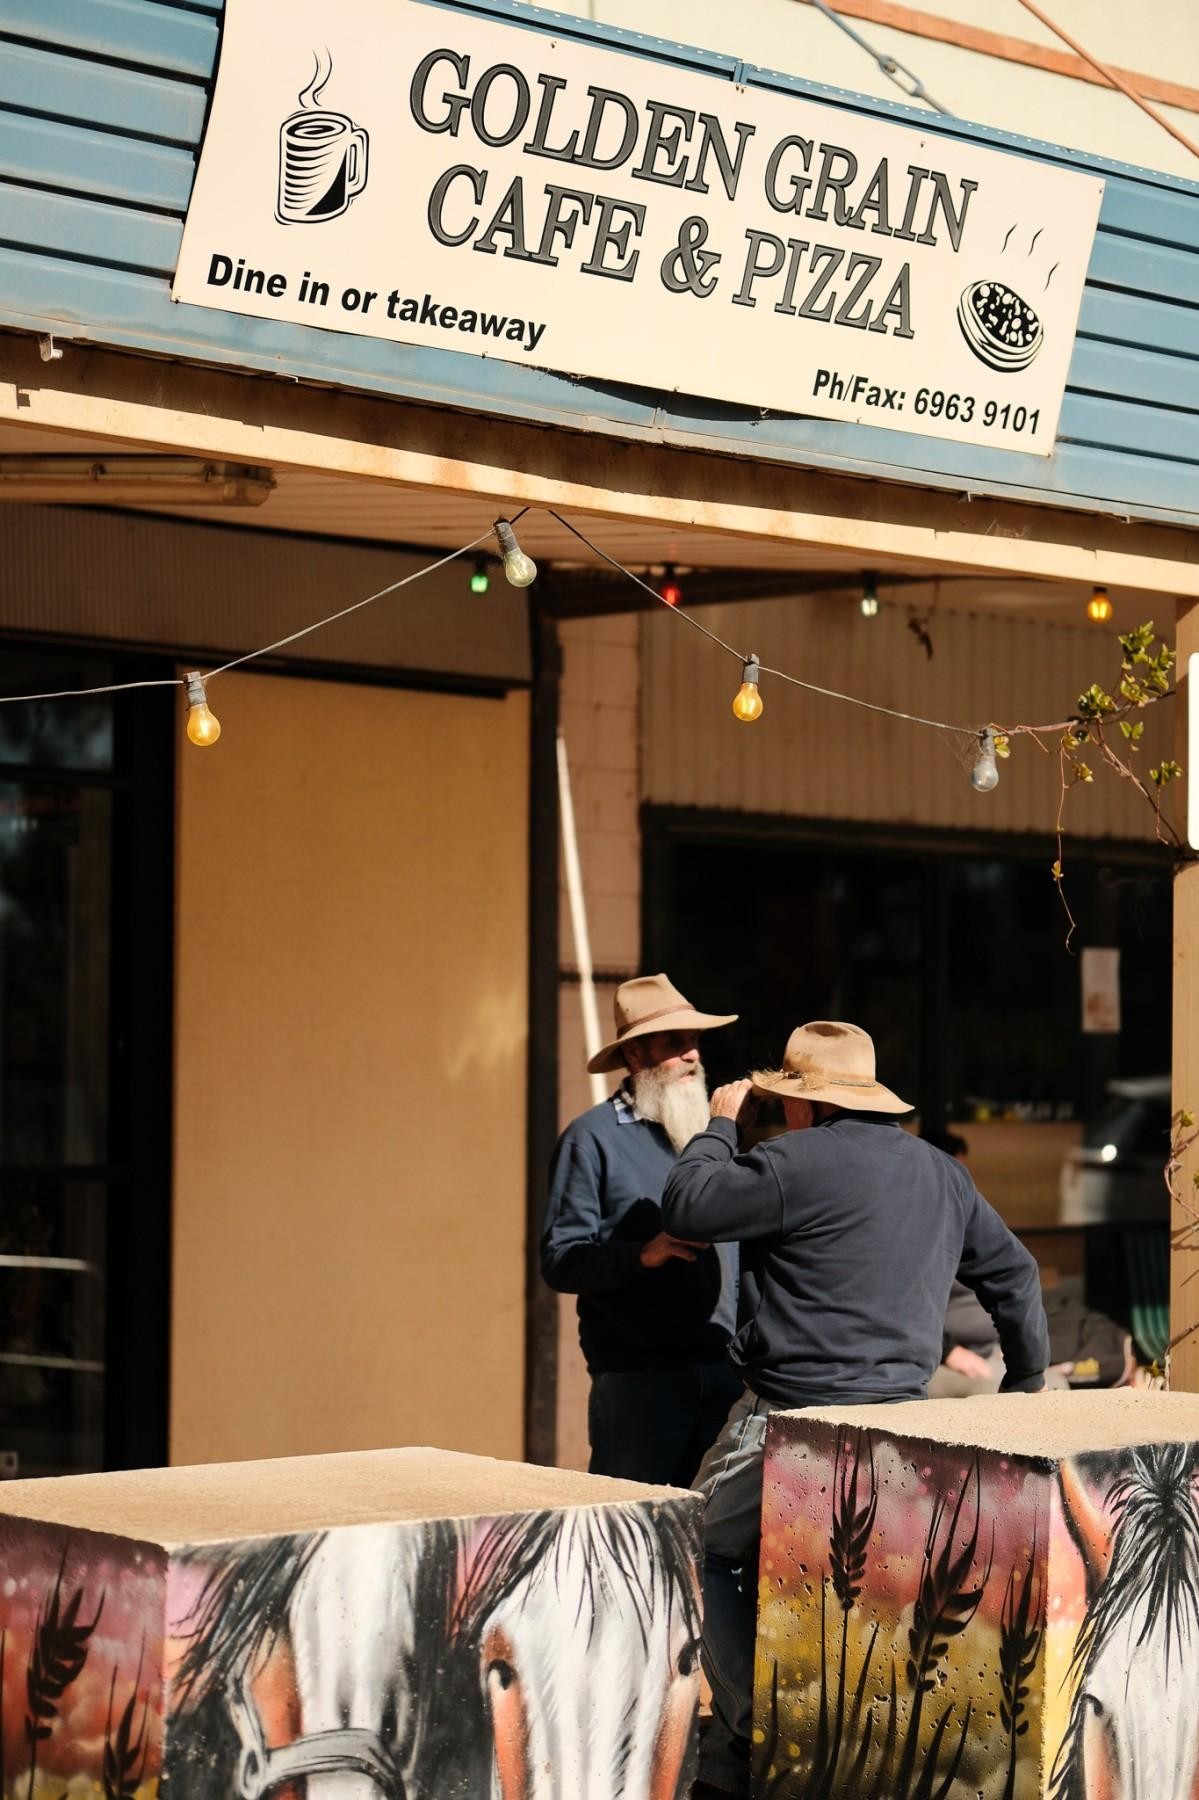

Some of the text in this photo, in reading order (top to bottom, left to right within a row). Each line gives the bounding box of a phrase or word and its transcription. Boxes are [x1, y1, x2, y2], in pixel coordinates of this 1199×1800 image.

[410, 48, 979, 253] GOLDEN GRAIN
[206, 253, 547, 352] Dine in or takeaway
[427, 163, 915, 340] CAFE & PIZZA
[812, 368, 1041, 435] Ph/Fax: 6963 9101
